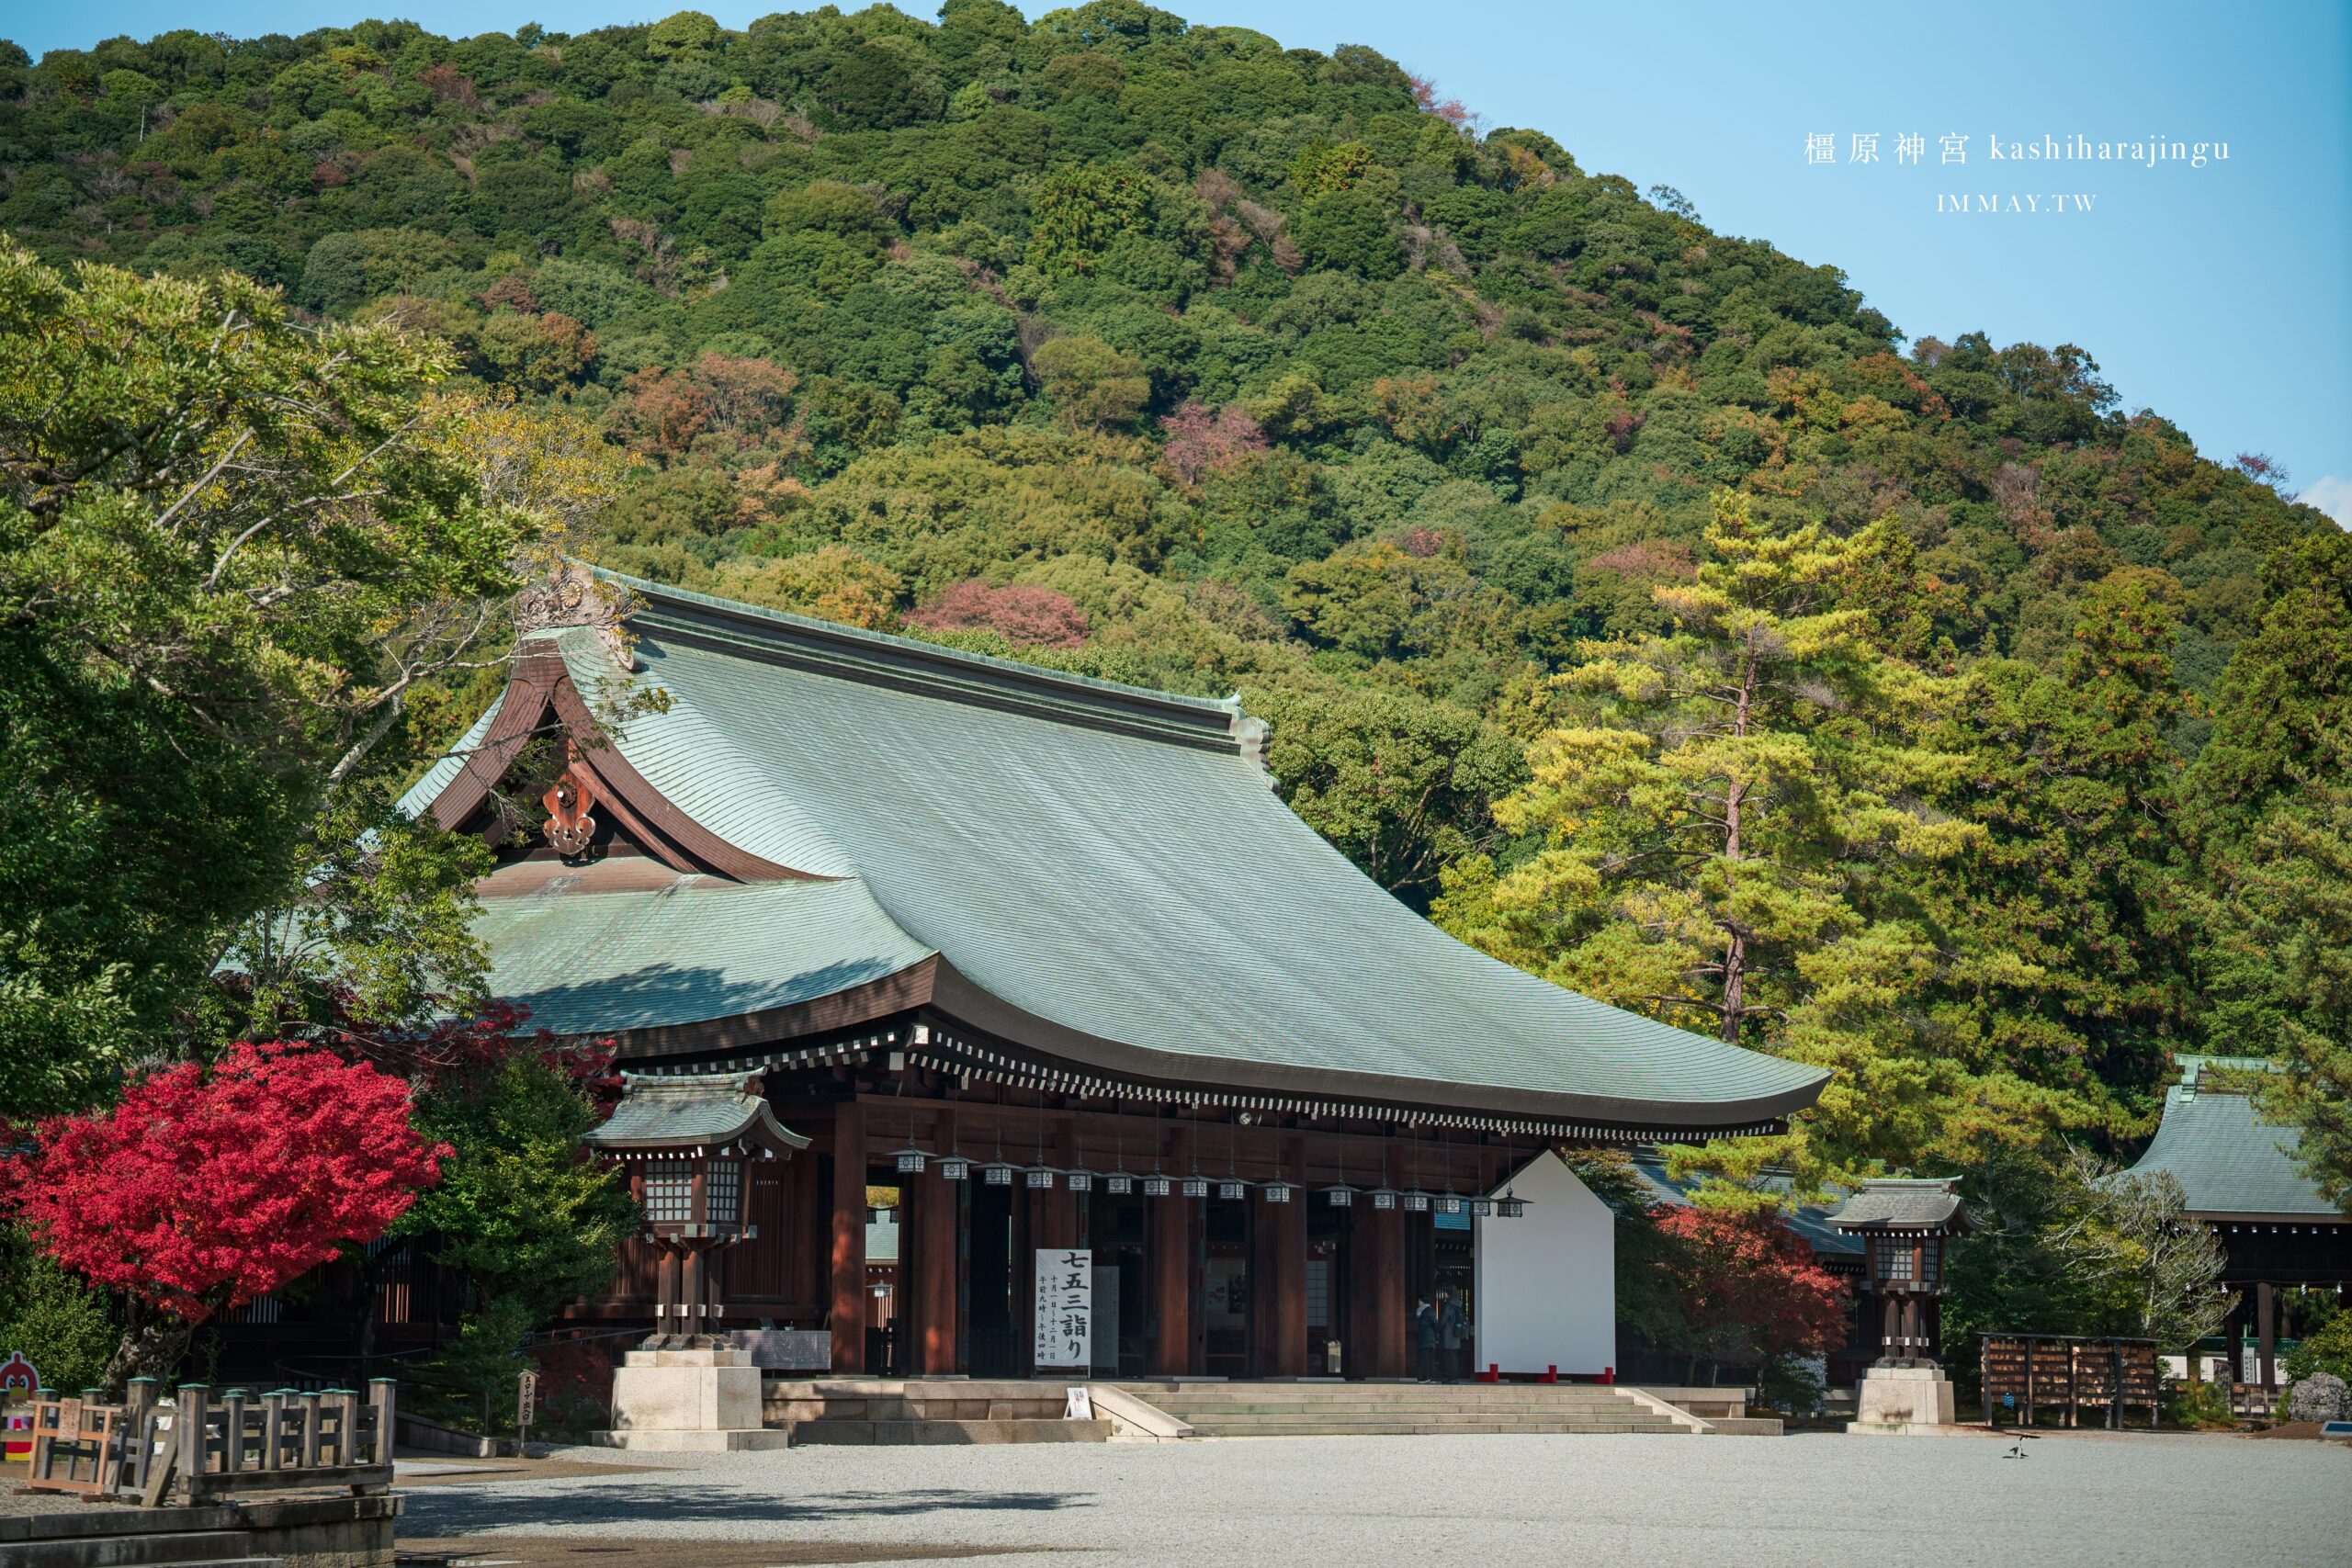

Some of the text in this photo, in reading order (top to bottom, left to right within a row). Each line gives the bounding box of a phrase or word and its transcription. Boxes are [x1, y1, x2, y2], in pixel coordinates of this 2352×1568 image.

[1059, 1251, 1090, 1359] 七五三詣り
